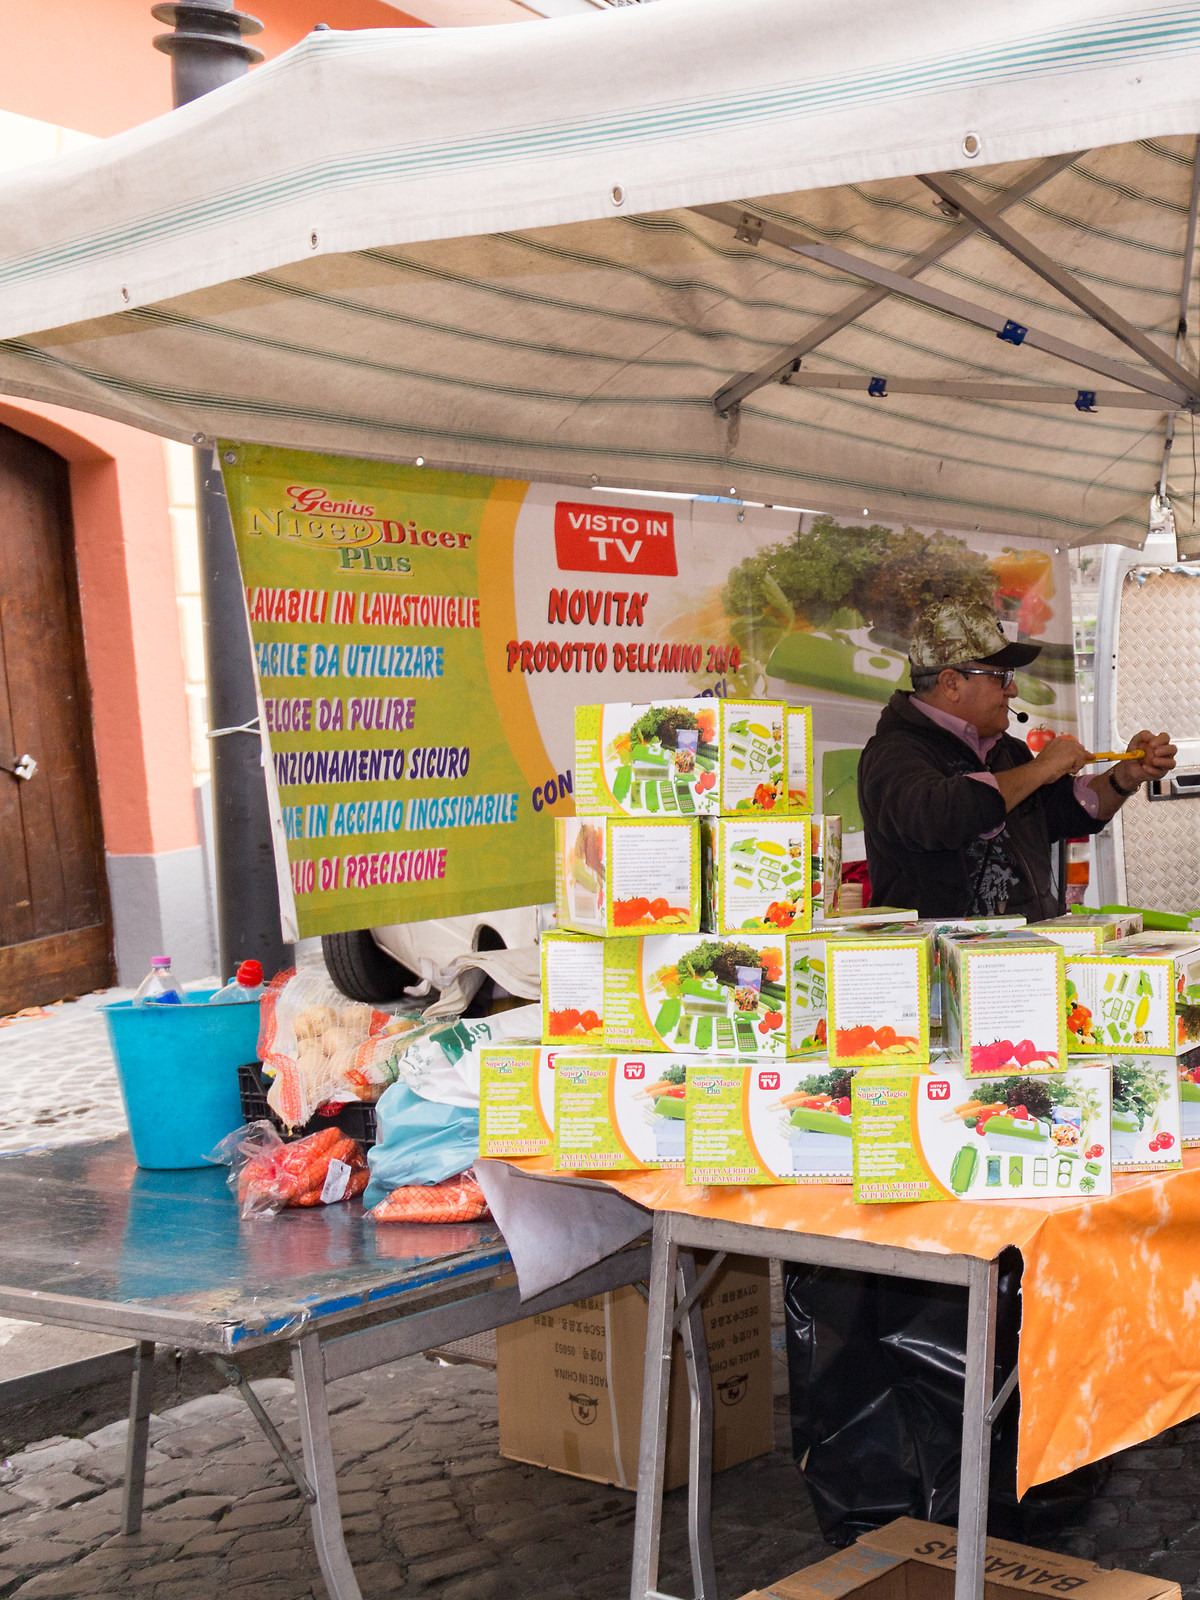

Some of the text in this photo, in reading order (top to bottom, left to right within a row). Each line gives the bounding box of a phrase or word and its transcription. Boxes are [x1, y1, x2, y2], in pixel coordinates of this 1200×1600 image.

[287, 486, 375, 517] Genius
[247, 506, 472, 549] Nicer Dicer
[568, 513, 668, 537] VISTO IN
[338, 547, 412, 572] Plus
[589, 536, 643, 563] TV
[331, 590, 356, 625] IN
[359, 591, 481, 629] LAVASTOVIGLIE
[548, 587, 649, 627] NOVITA'
[310, 643, 340, 677] DA
[342, 644, 444, 680] UTILIZZARE
[506, 640, 742, 674] PRODOTTO DELL'ANNO 2014
[264, 697, 417, 732] ELOCE DA PULIRE
[272, 747, 470, 786] NZIONAMENTO SICURO
[532, 769, 574, 812] CON
[282, 793, 519, 840] ME IN ACCIAIO INOSSIDABILE
[318, 856, 341, 891] DI
[343, 848, 448, 889] PRECISIONE
[626, 1068, 643, 1077] TV
[692, 1079, 741, 1088] Super Magico
[760, 1078, 778, 1088] TV
[857, 1090, 908, 1099] Super Magico
[929, 1088, 947, 1097] TV
[860, 1183, 890, 1191] TAGLIA
[860, 1190, 920, 1199] SUPER MAGICO
[708, 1348, 760, 1374] MADE IN CHIN
[554, 1368, 578, 1382] CHINA
[579, 1372, 587, 1384] IN
[914, 1541, 1089, 1592] BANAAS
